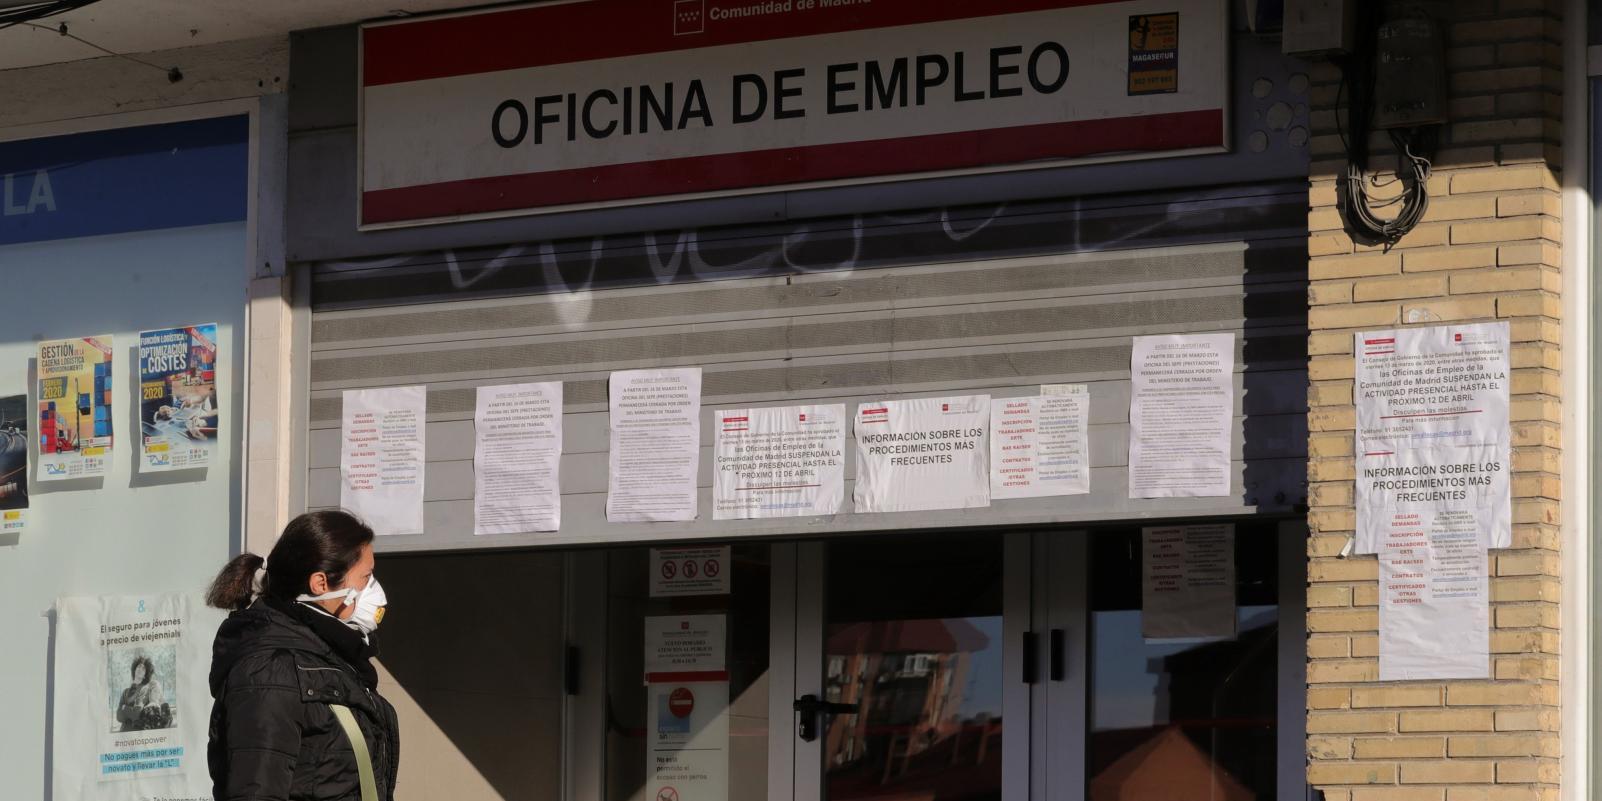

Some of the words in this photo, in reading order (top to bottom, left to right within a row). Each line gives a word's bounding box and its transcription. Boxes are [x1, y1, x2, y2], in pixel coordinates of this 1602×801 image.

[709, 0, 792, 21] Comunidad
[797, 0, 814, 10] de
[491, 78, 714, 150] OFICINA
[732, 67, 806, 125] DE
[825, 40, 1070, 115] EMPLEO
[41, 341, 74, 360] GESTIÓN
[140, 342, 188, 359] OPTIMIZACIÓN
[42, 359, 60, 368] CADENA
[147, 354, 187, 374] COSTES
[1392, 368, 1423, 377] Oficinas
[1436, 366, 1464, 375] Empleo
[1360, 379, 1401, 389] Comunidad
[1415, 376, 1441, 385] Madrid
[1443, 373, 1492, 383] SUSPENDAN
[42, 385, 62, 400] 2020
[143, 387, 163, 400] 2020
[1365, 389, 1406, 398] ACTIVIDAD
[1408, 386, 1458, 395] PRESENCIAL
[1460, 384, 1486, 392] HASTA
[1451, 394, 1474, 402] ABRIL
[929, 429, 961, 440] SOBRE
[963, 428, 982, 438] LOS
[788, 451, 830, 459] SUSPENDAN
[869, 442, 952, 455] PROCEDIMIENTOS
[890, 454, 952, 466] FRECUENTES
[1439, 464, 1476, 474] SOBRE
[1479, 462, 1500, 472] LOS
[1372, 477, 1466, 491] PROCEDIMIENTOS
[1396, 490, 1466, 502] FRECUENTES
[100, 624, 107, 634] El
[108, 623, 132, 633] seguro
[134, 622, 150, 632] para
[106, 636, 129, 647] precio
[130, 633, 140, 642] de
[114, 734, 168, 748] #novatospower
[104, 753, 114, 761] No
[116, 752, 139, 762] pagues
[156, 749, 168, 759] por
[108, 764, 131, 772] novato
[137, 761, 155, 770] llevar
[157, 760, 164, 769] la
